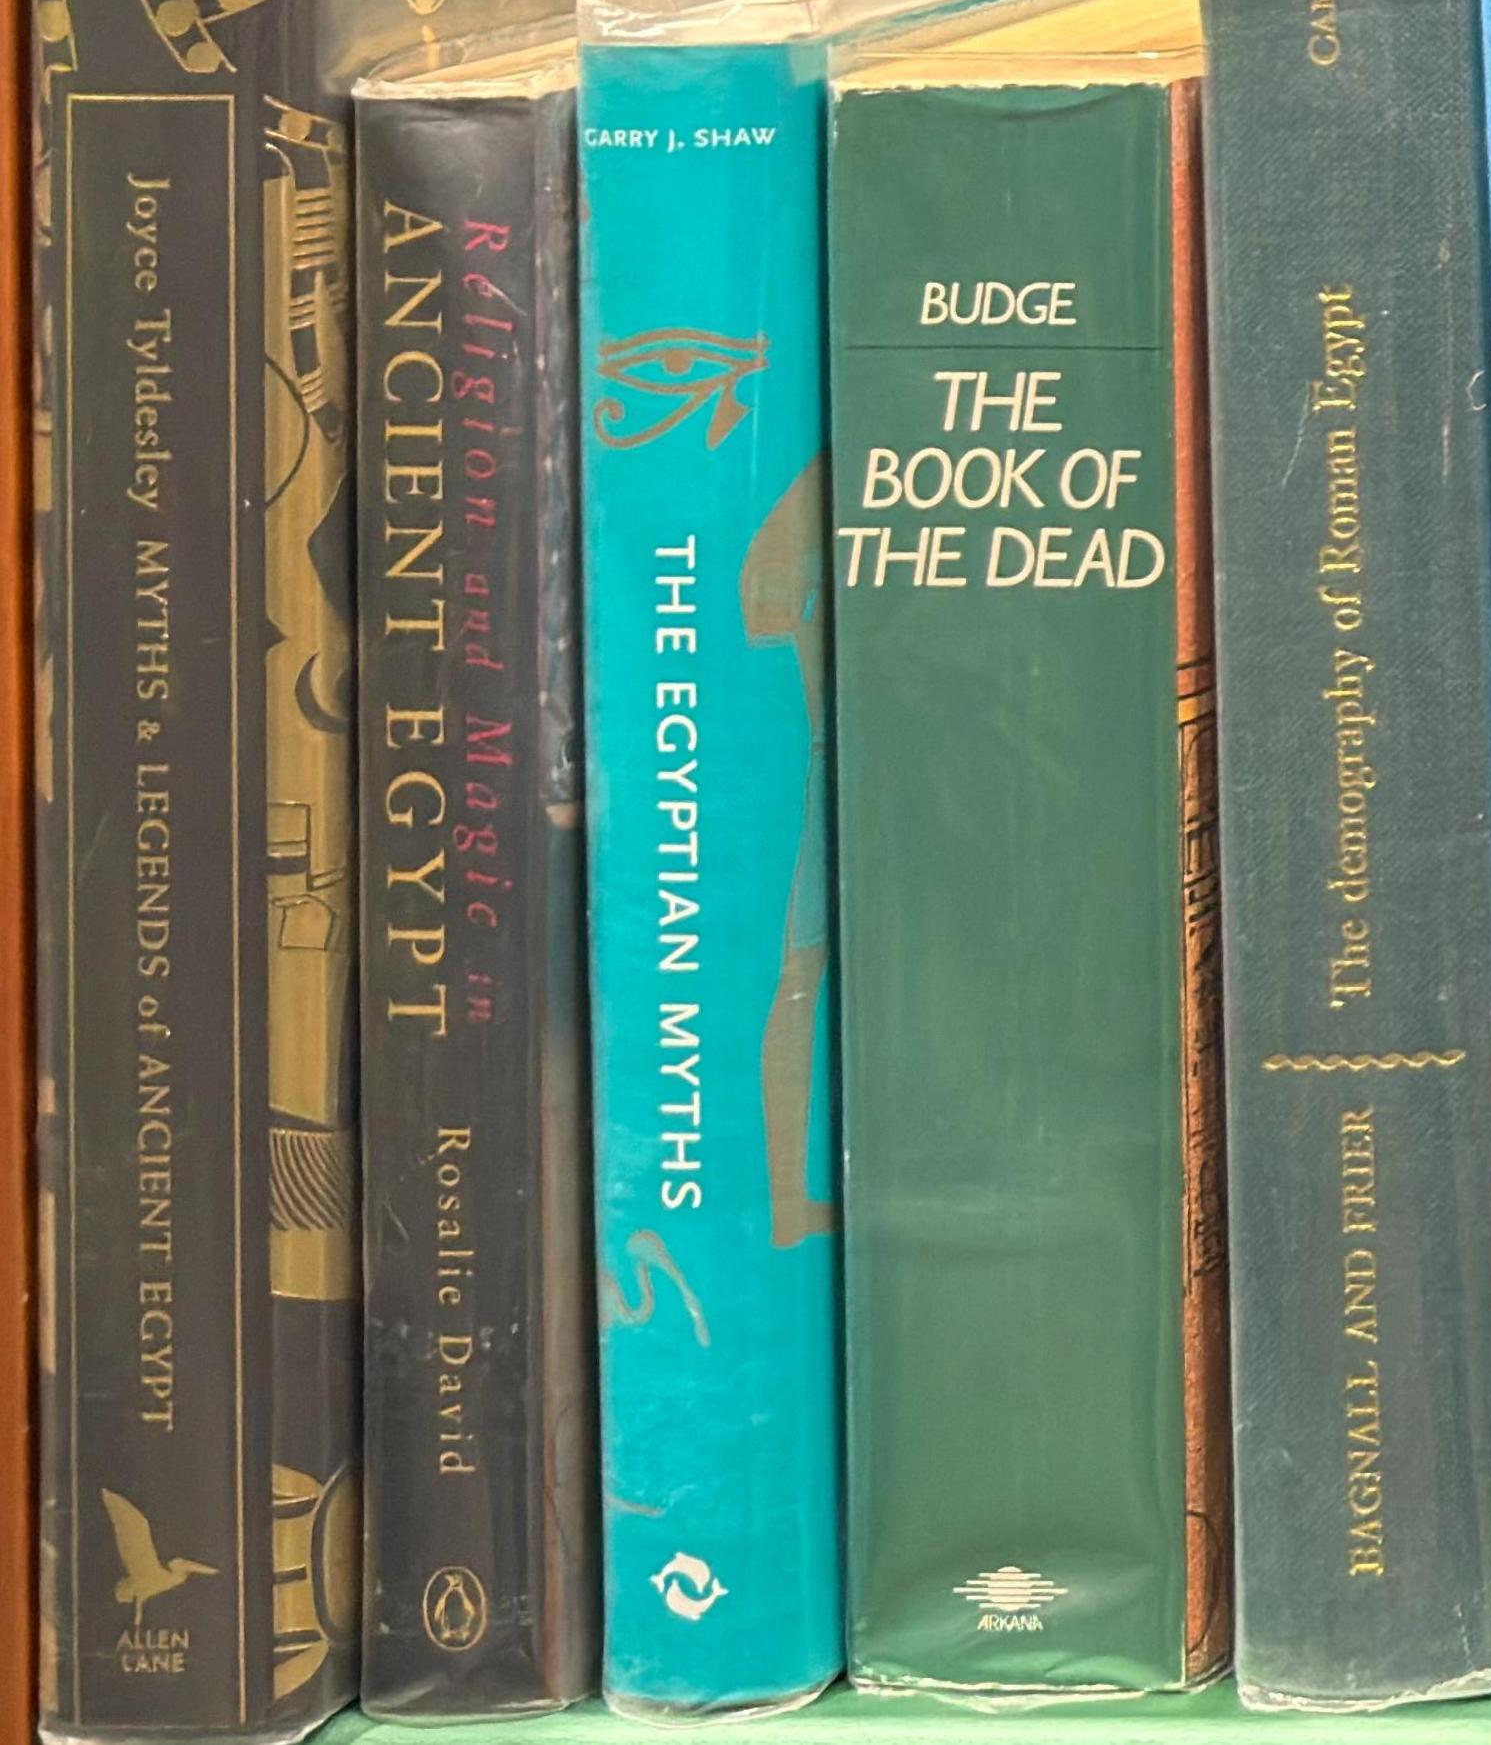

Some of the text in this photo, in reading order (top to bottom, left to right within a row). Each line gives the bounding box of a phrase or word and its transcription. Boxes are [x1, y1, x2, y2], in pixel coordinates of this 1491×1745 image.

[584, 126, 777, 154] GARRY J. SHAW
[920, 281, 1077, 327] BUDGE
[450, 219, 518, 528] Religion
[934, 370, 1063, 434] THE
[861, 448, 1142, 510] BOOK OF
[837, 527, 1166, 589] THE DEAD
[384, 199, 447, 1038] ANCIENT EGYPT
[464, 573, 504, 671] and
[127, 171, 175, 1433] Joyce Tyldesley MYTHS & LEGENDS of ANCIENT EGYPT
[453, 713, 514, 929] Magic
[654, 534, 703, 1211] THE EGYPTIAN MYTHS
[1311, 284, 1384, 1579] BAGNALL AND FRIER The demography of Roman Egypt
[437, 1125, 475, 1476] Rosalie David
[115, 1629, 190, 1651] ALLEN
[121, 1652, 186, 1675] LANE
[976, 1614, 1045, 1633] ARKANA
